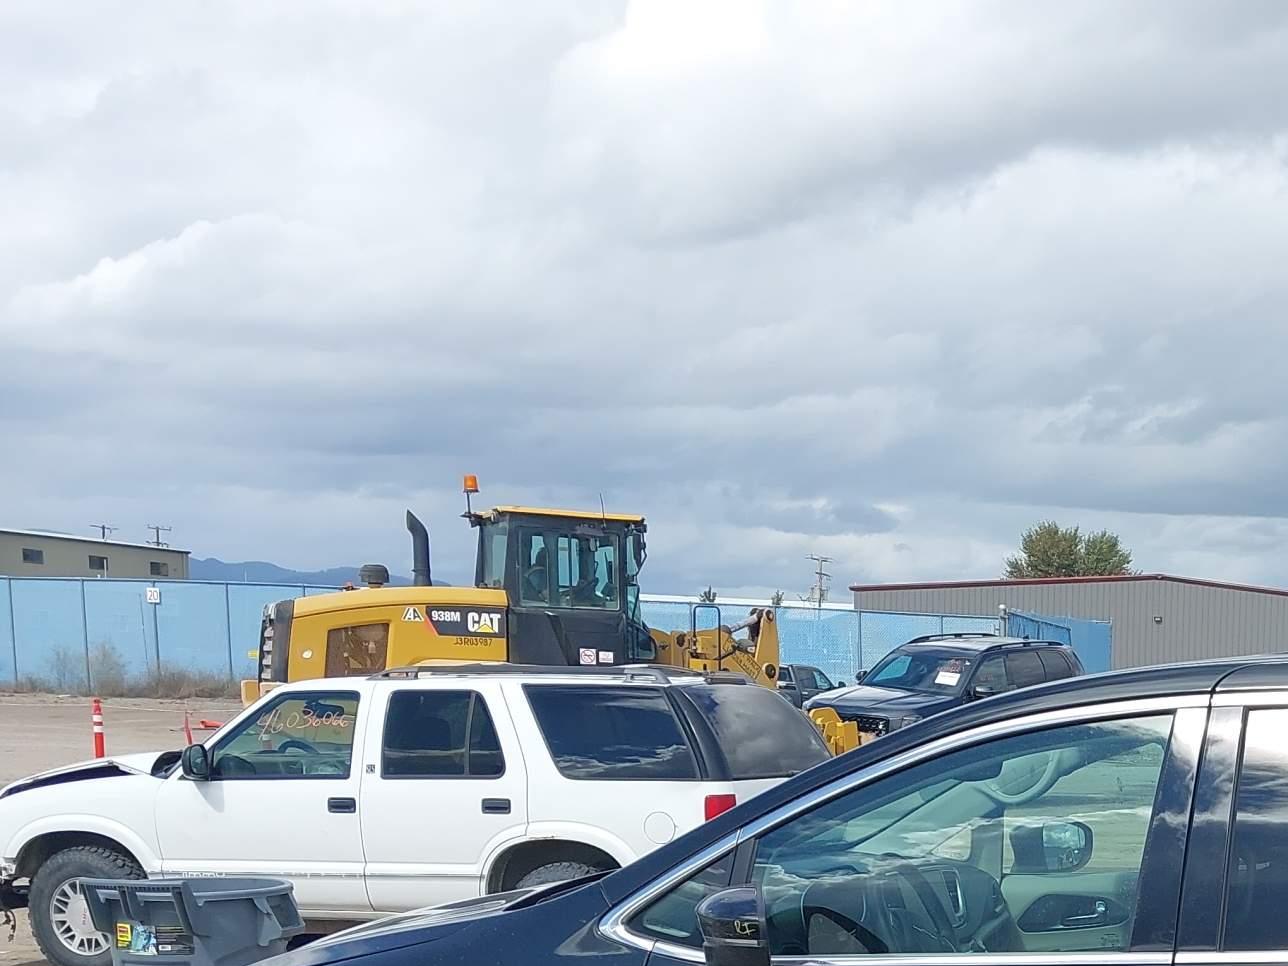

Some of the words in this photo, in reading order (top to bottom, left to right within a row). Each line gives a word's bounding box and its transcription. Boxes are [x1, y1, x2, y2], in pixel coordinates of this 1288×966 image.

[148, 590, 159, 601] 20
[431, 610, 461, 622] 938M
[467, 611, 502, 633] CAT
